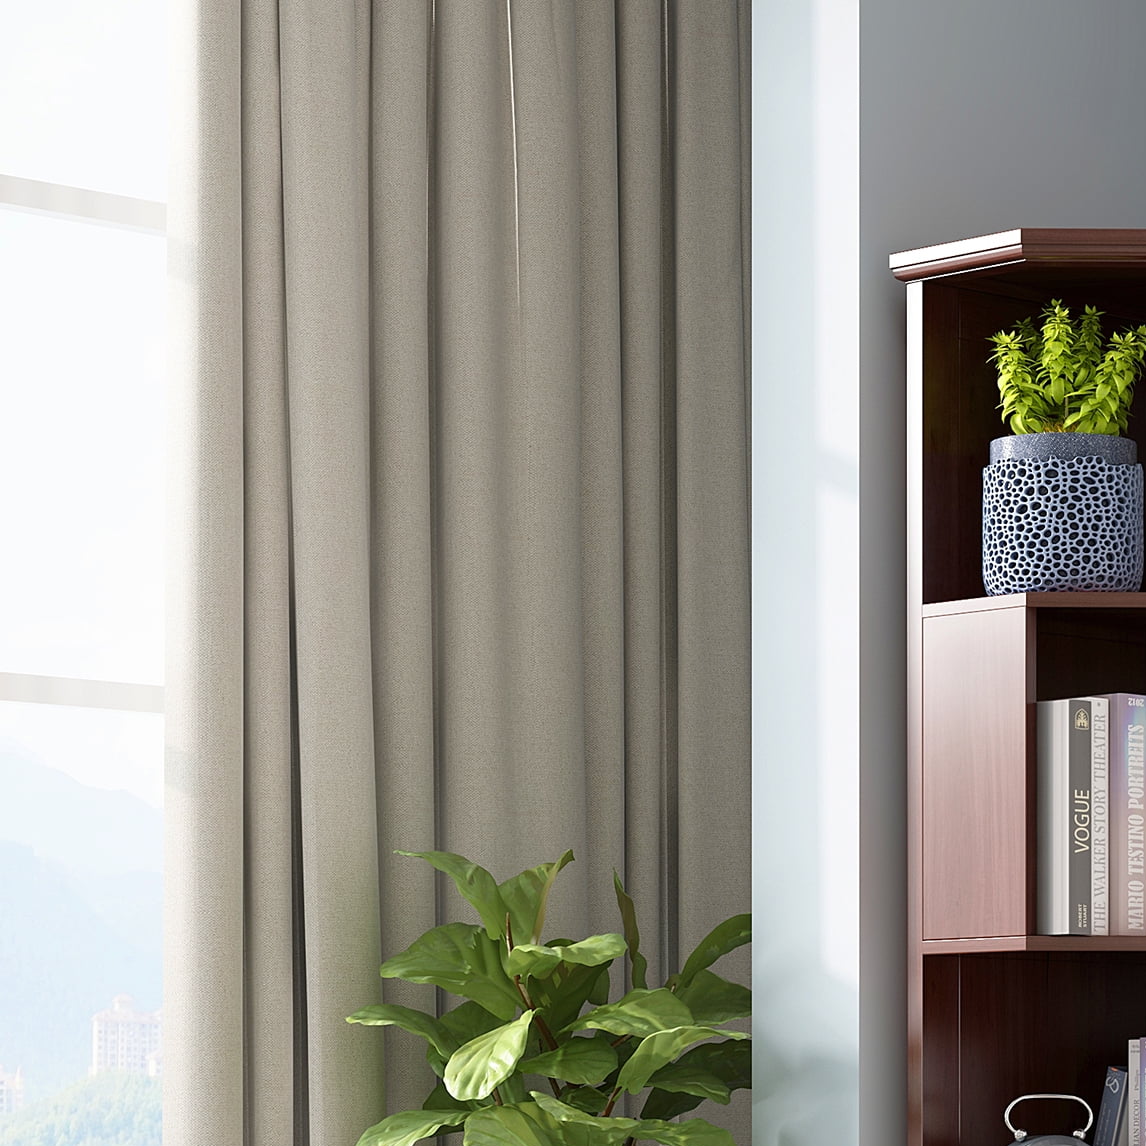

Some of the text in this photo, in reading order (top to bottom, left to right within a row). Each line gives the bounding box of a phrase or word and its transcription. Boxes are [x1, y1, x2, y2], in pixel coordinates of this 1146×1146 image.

[1127, 697, 1145, 707] 2012
[1074, 789, 1090, 853] VOGUE
[1093, 714, 1106, 932] THE WALKER STORY THEATER
[1127, 724, 1145, 930] MARIO TESTINO PORTREITS
